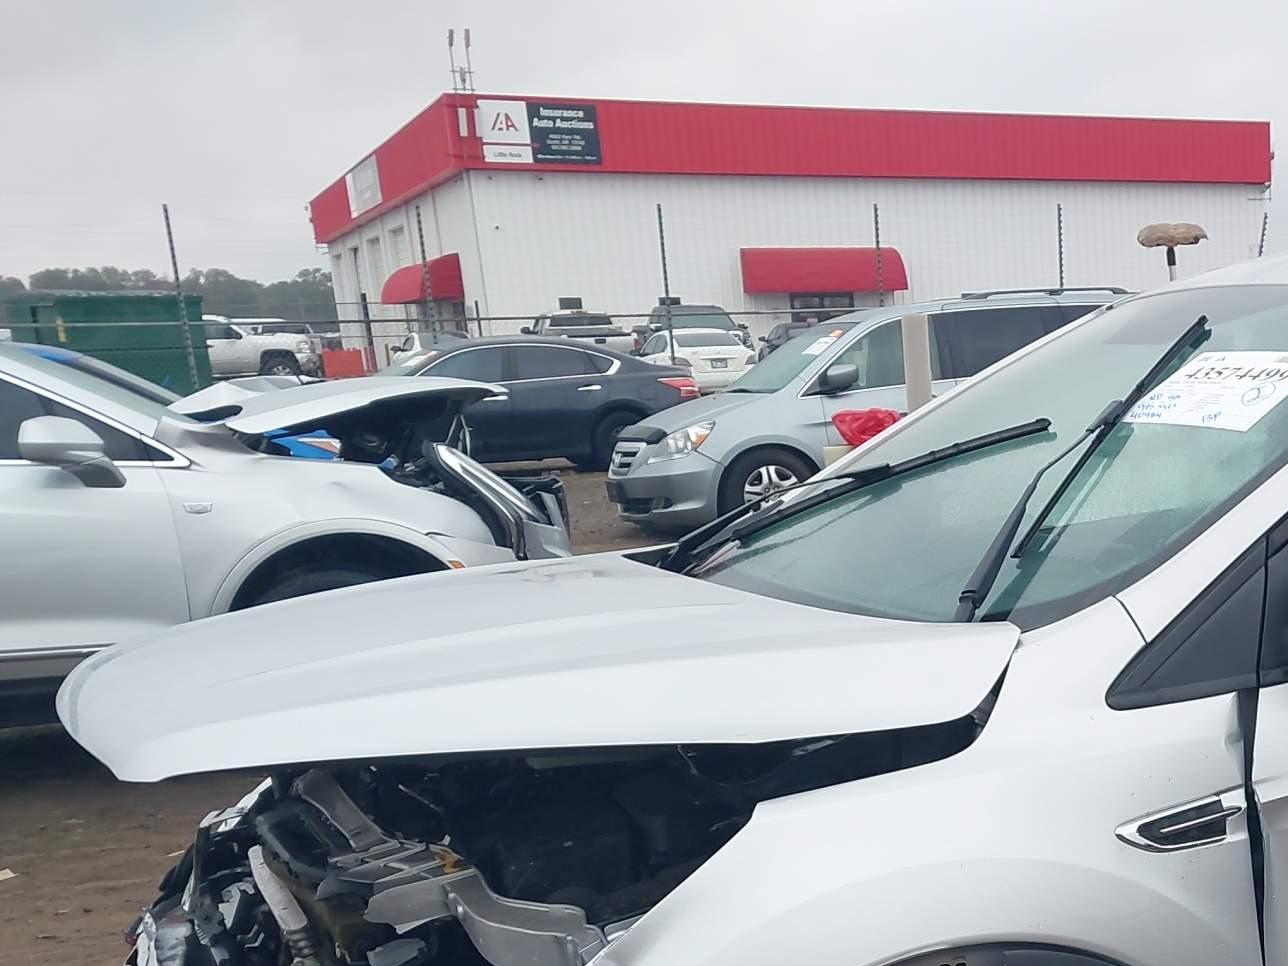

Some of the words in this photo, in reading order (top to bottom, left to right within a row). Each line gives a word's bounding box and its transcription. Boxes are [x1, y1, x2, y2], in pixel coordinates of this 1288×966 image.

[539, 106, 584, 118] Insurance
[532, 117, 554, 128] Auto
[555, 118, 594, 129] Auctions
